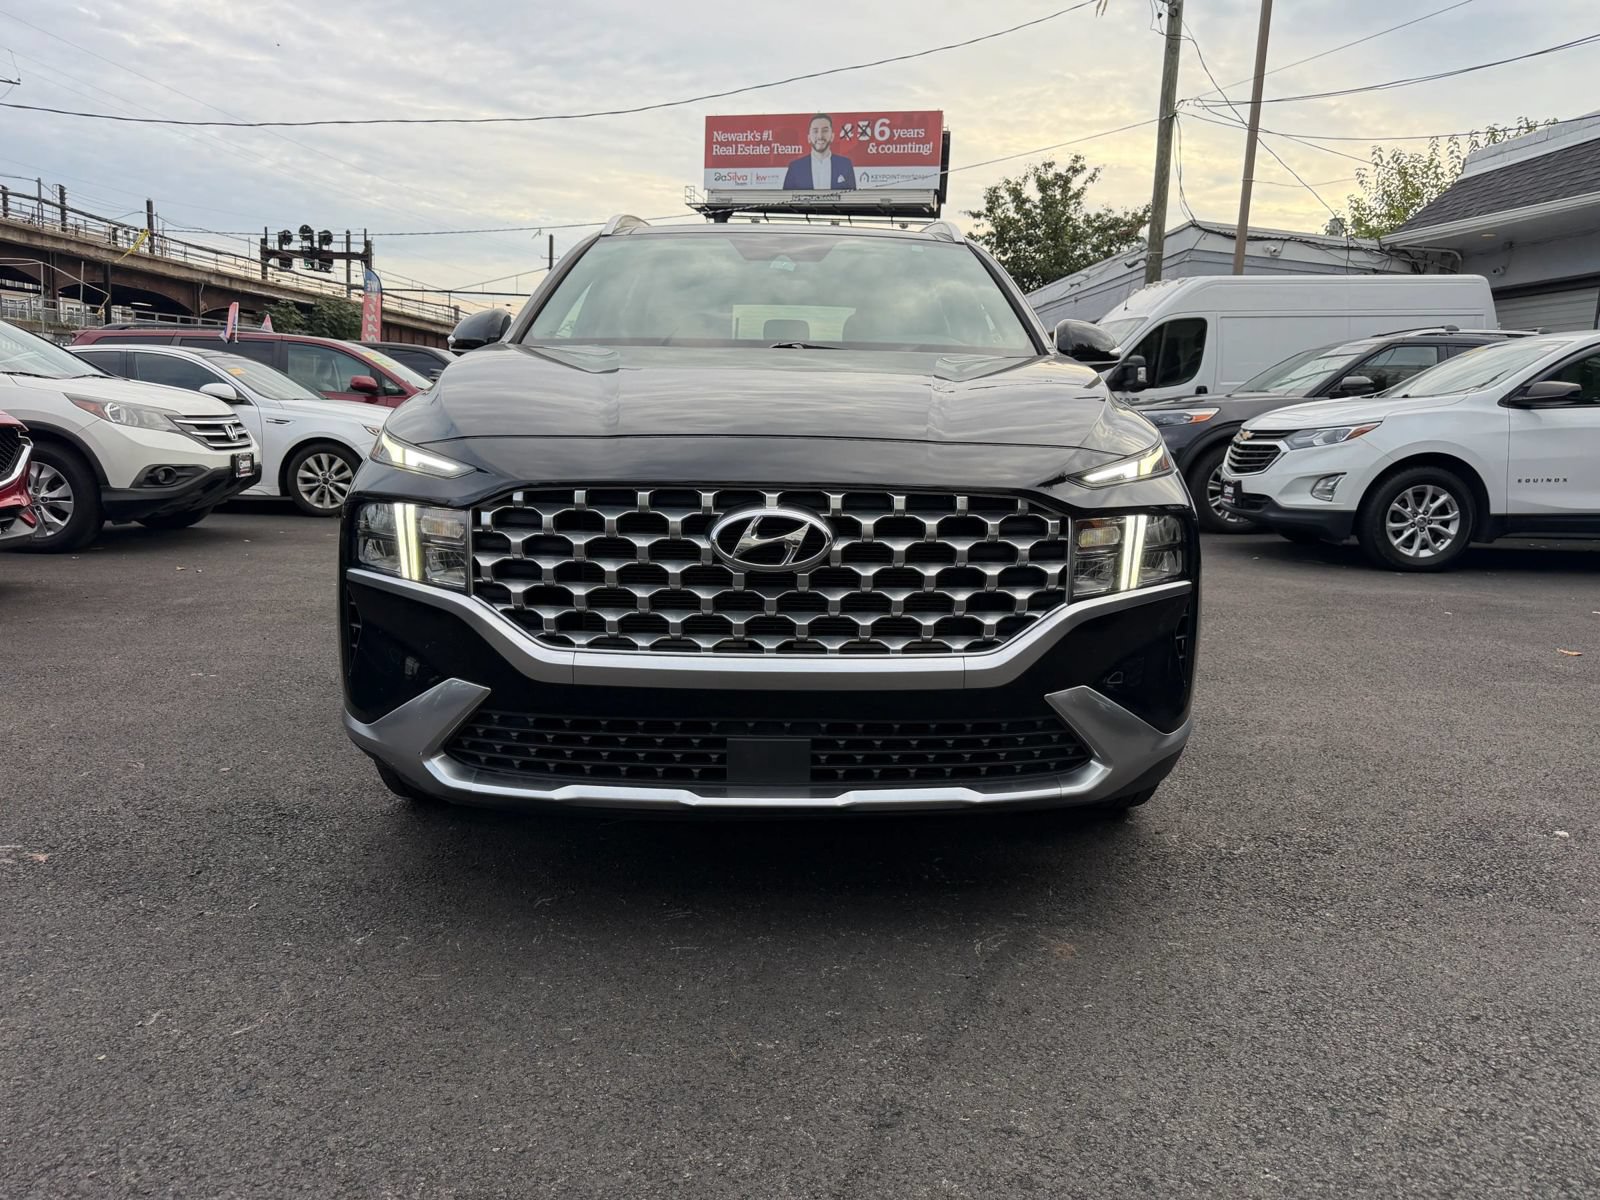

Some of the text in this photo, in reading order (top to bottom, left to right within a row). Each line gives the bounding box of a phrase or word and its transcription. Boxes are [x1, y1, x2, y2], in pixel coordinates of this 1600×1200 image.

[874, 117, 891, 141] 6
[893, 128, 925, 141] years
[713, 130, 774, 143] Newark's #1
[712, 143, 804, 156] Real Estate Team
[867, 141, 934, 156] & counting!
[755, 172, 768, 182] kw
